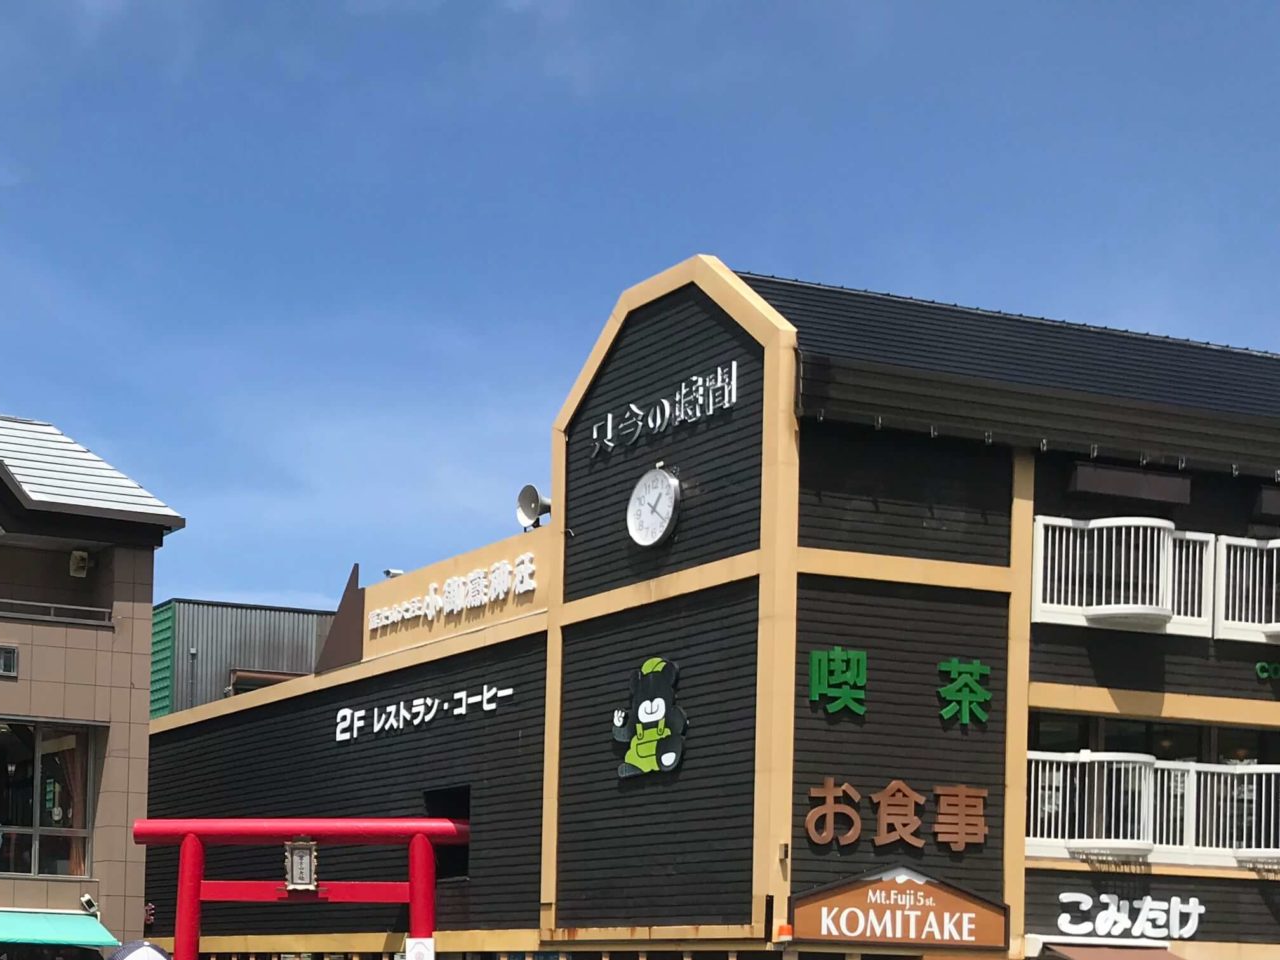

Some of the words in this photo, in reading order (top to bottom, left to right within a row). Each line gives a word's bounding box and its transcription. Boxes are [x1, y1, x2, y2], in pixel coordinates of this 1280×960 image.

[336, 707, 365, 742] 2F
[805, 777, 988, 852] お食事
[821, 906, 976, 941] KOMITAKE
[1057, 892, 1206, 939] こみたけ
